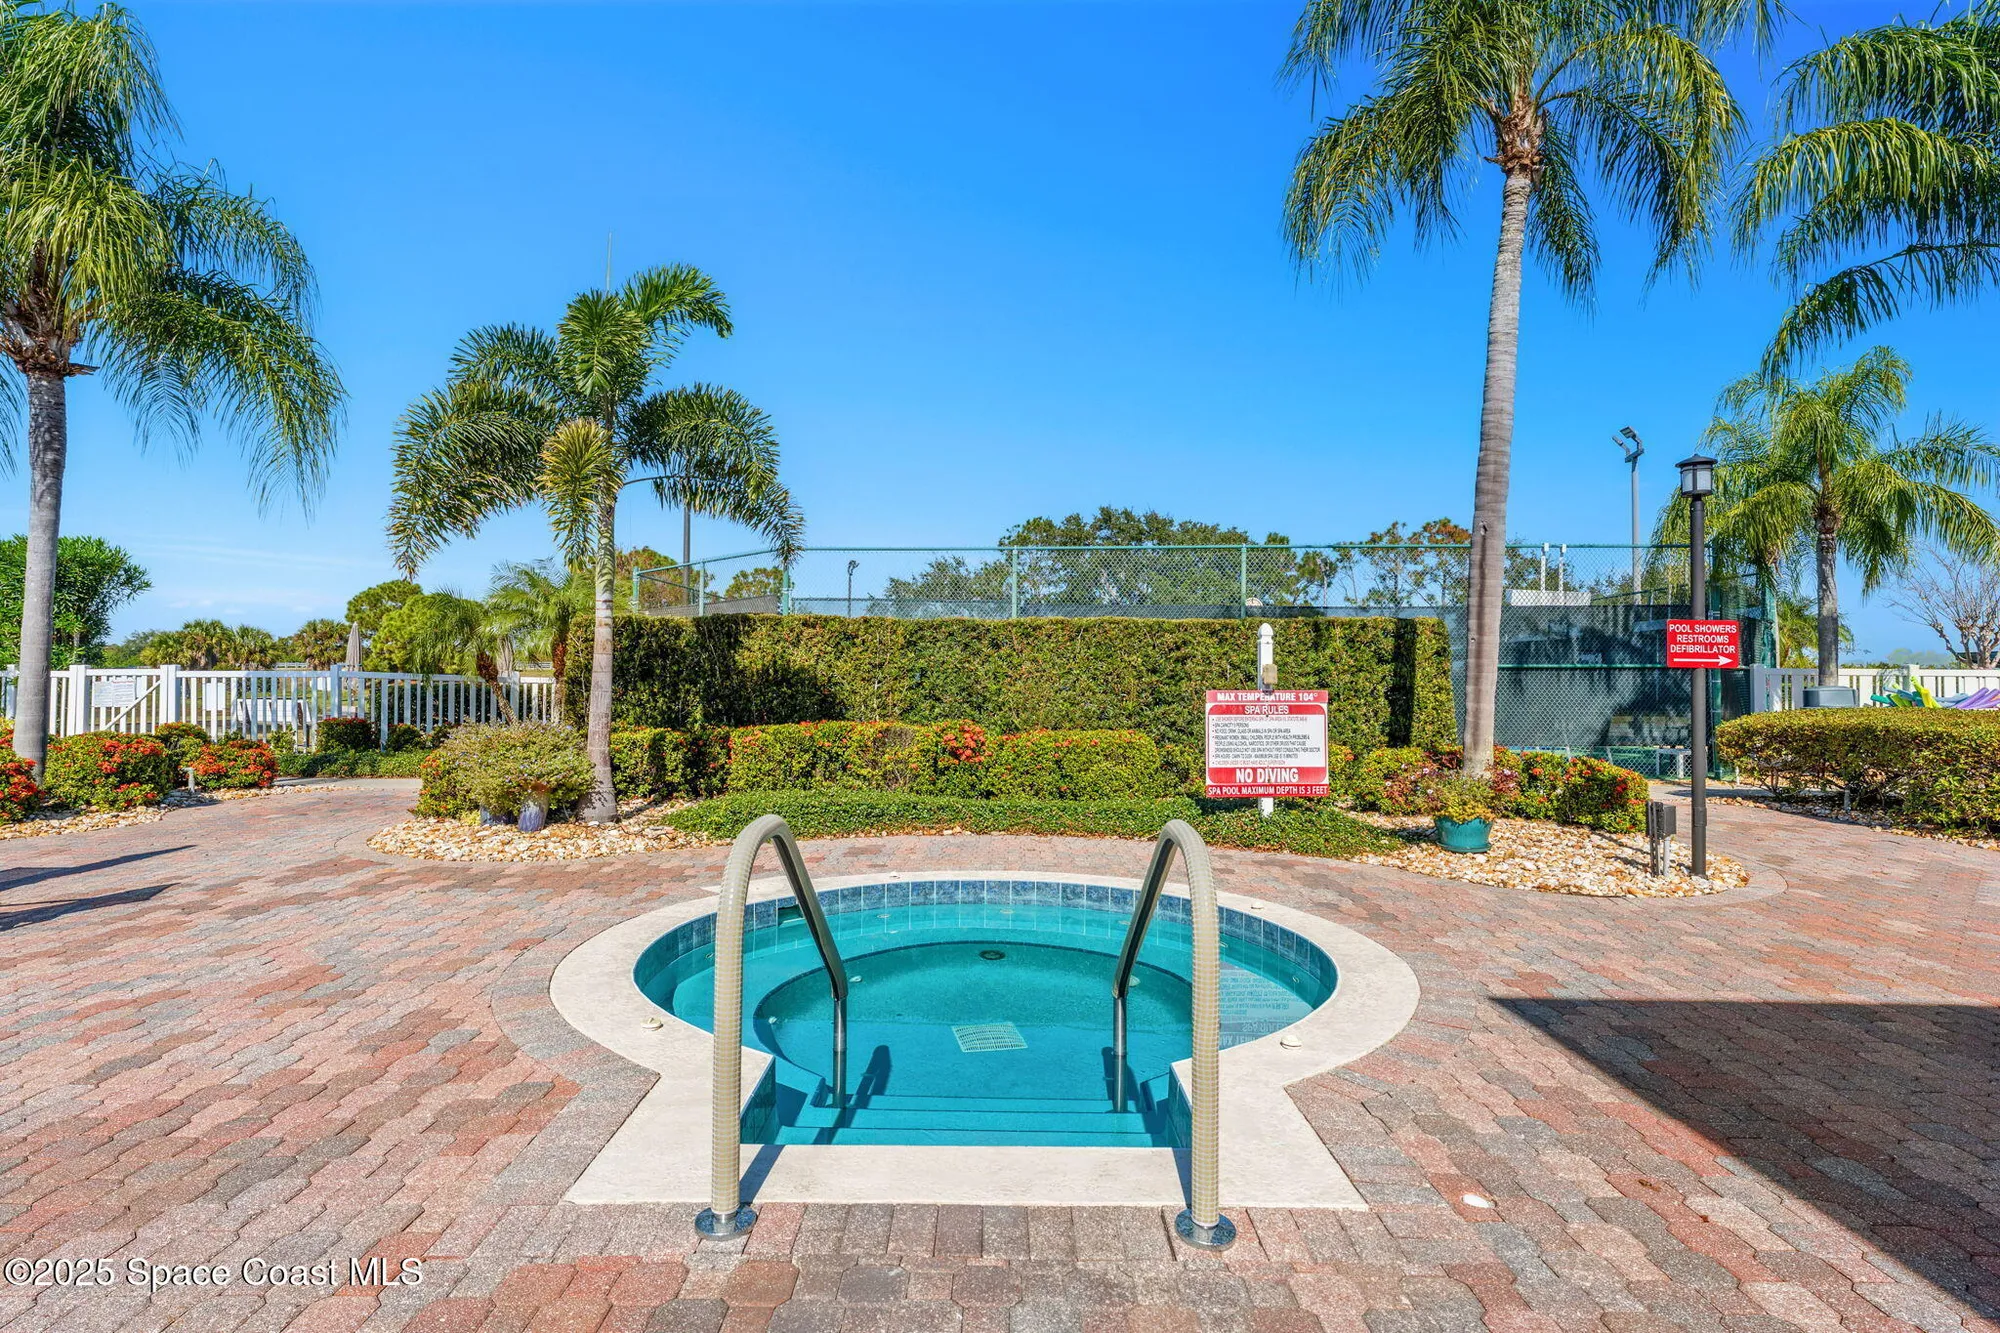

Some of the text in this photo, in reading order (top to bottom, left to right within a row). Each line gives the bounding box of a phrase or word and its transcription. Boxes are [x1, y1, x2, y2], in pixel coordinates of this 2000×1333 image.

[1669, 624, 1737, 633] POOL SHOWERS
[1676, 635, 1729, 643] RESTROOMS
[1670, 645, 1736, 653] DEFIBRILLATOR
[1217, 692, 1236, 701] MAX
[1237, 692, 1296, 701] TEMPERATURE
[1244, 705, 1289, 715] SPA RULES
[1235, 768, 1299, 783] NO DIVING
[1208, 785, 1328, 795] SPA POOL MAXIMUM DEPTH IS 3 FEET
